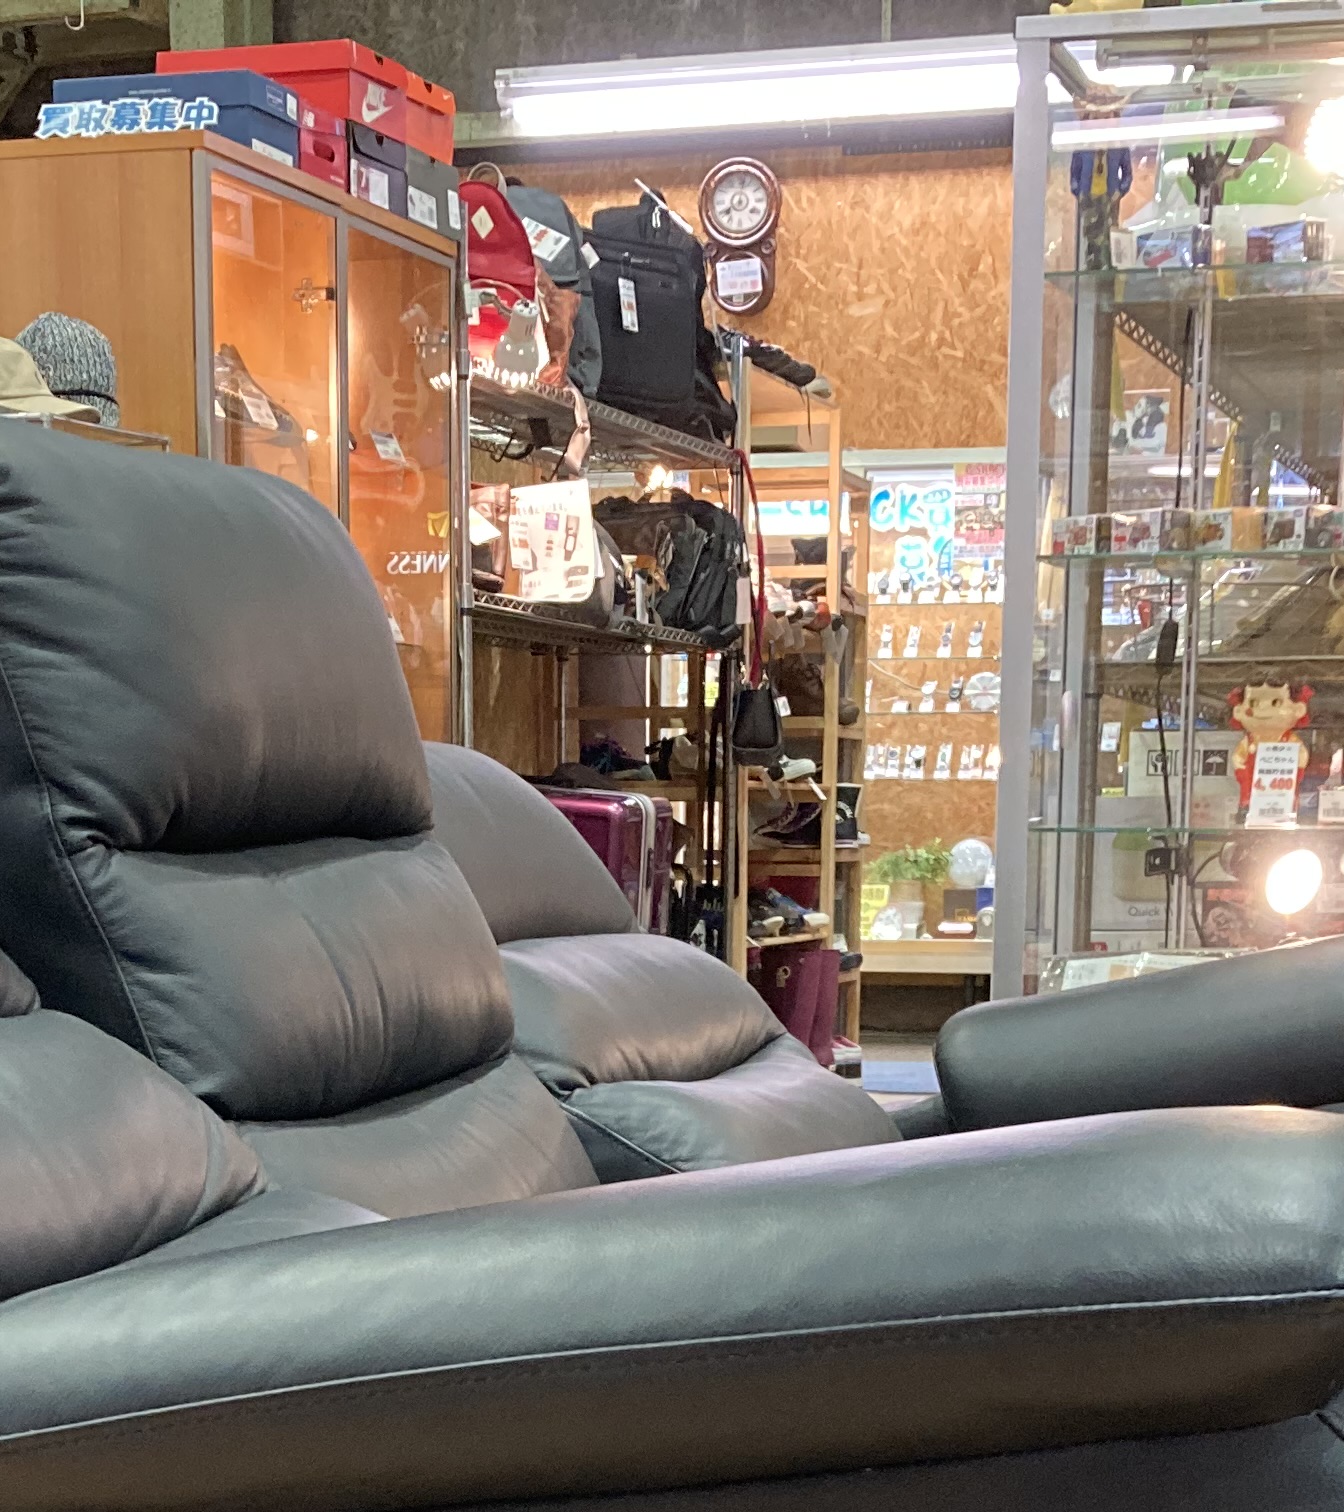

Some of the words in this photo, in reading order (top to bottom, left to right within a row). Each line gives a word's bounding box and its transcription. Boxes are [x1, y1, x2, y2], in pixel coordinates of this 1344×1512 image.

[35, 96, 218, 139] 買取募集中
